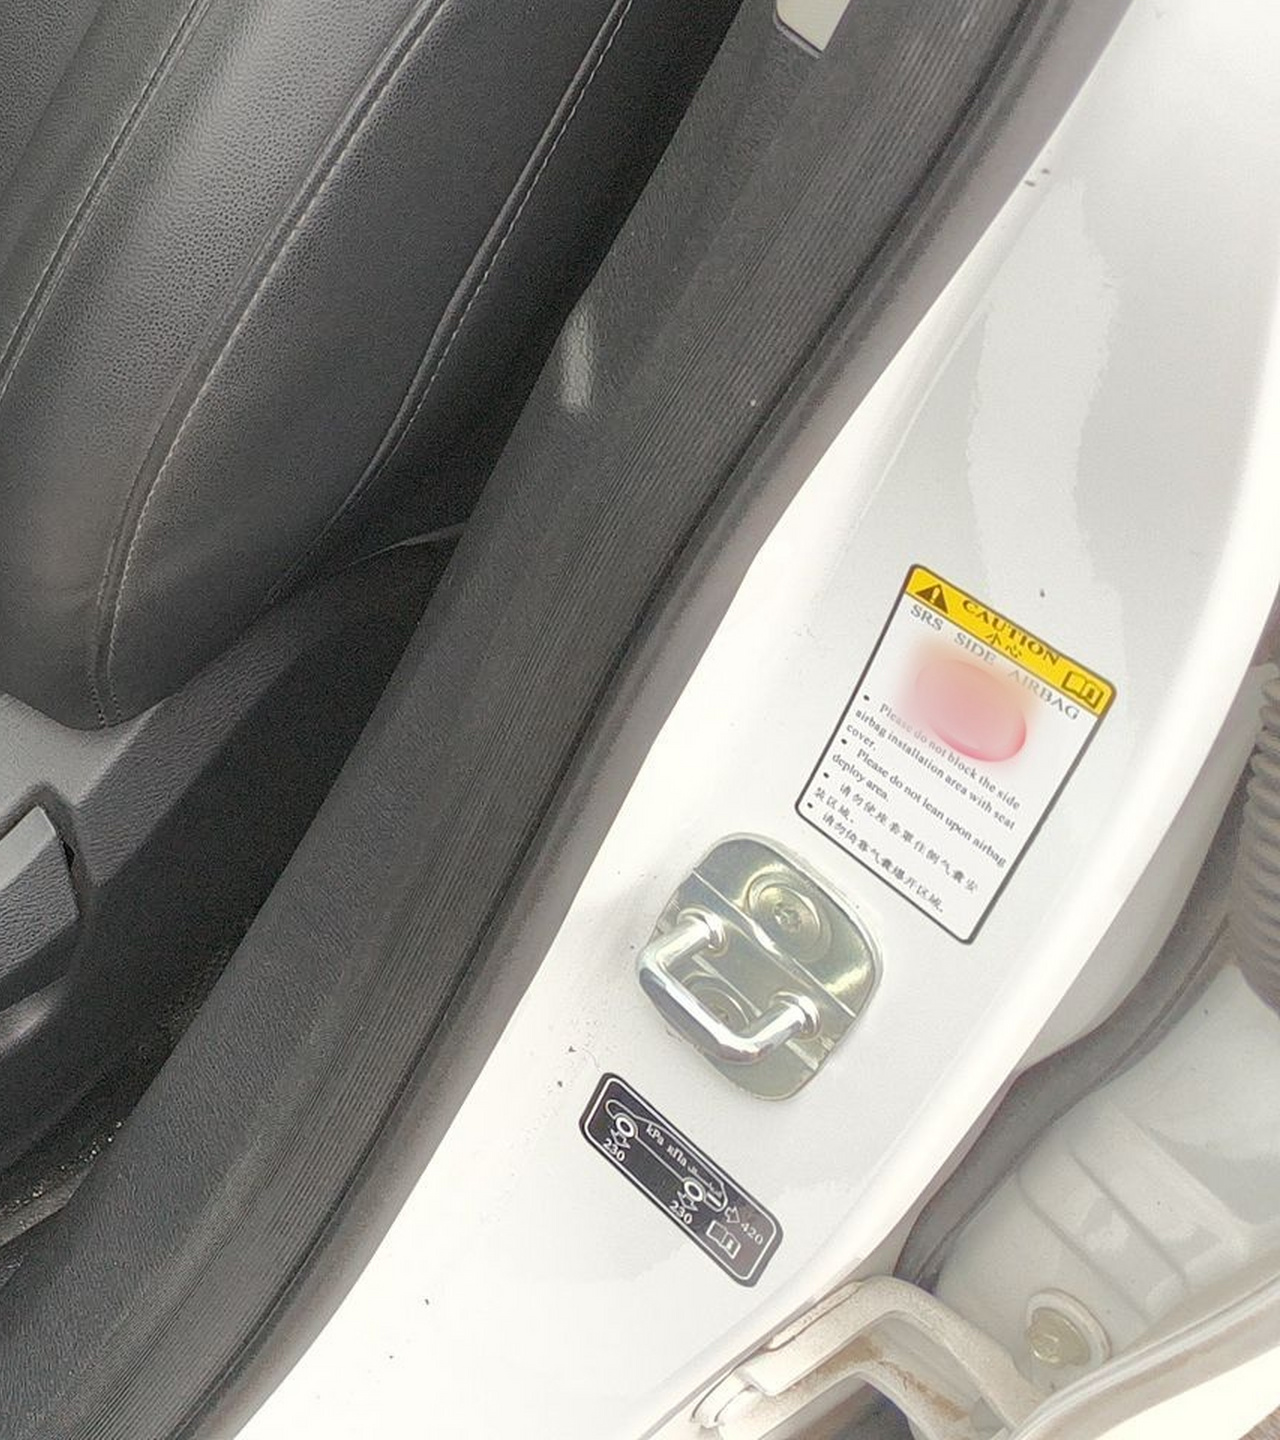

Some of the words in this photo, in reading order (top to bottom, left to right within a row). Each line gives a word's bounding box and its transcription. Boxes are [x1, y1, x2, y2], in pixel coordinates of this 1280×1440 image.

[962, 598, 1060, 666] CAUTION
[985, 631, 1023, 659] 小心
[910, 603, 944, 631] SRS
[953, 631, 998, 666] SIDE
[1008, 669, 1080, 721] AIRBAG
[832, 753, 867, 783] deploy
[855, 708, 887, 739] airbag
[887, 731, 946, 780] installation
[945, 772, 968, 796] area
[969, 790, 993, 814] with
[994, 809, 1017, 831] seat
[928, 741, 947, 757] not
[947, 750, 978, 780] block
[978, 774, 997, 793] the
[997, 789, 1021, 810] side
[856, 748, 890, 778] Please
[889, 774, 904, 789] do
[903, 786, 922, 804] not
[922, 797, 946, 821] lean
[945, 816, 973, 842] upon
[972, 836, 1007, 868] airbag
[602, 1137, 626, 1162] 230
[646, 1123, 665, 1147] kPa
[669, 1200, 693, 1225] 230
[740, 1223, 764, 1246] 420
